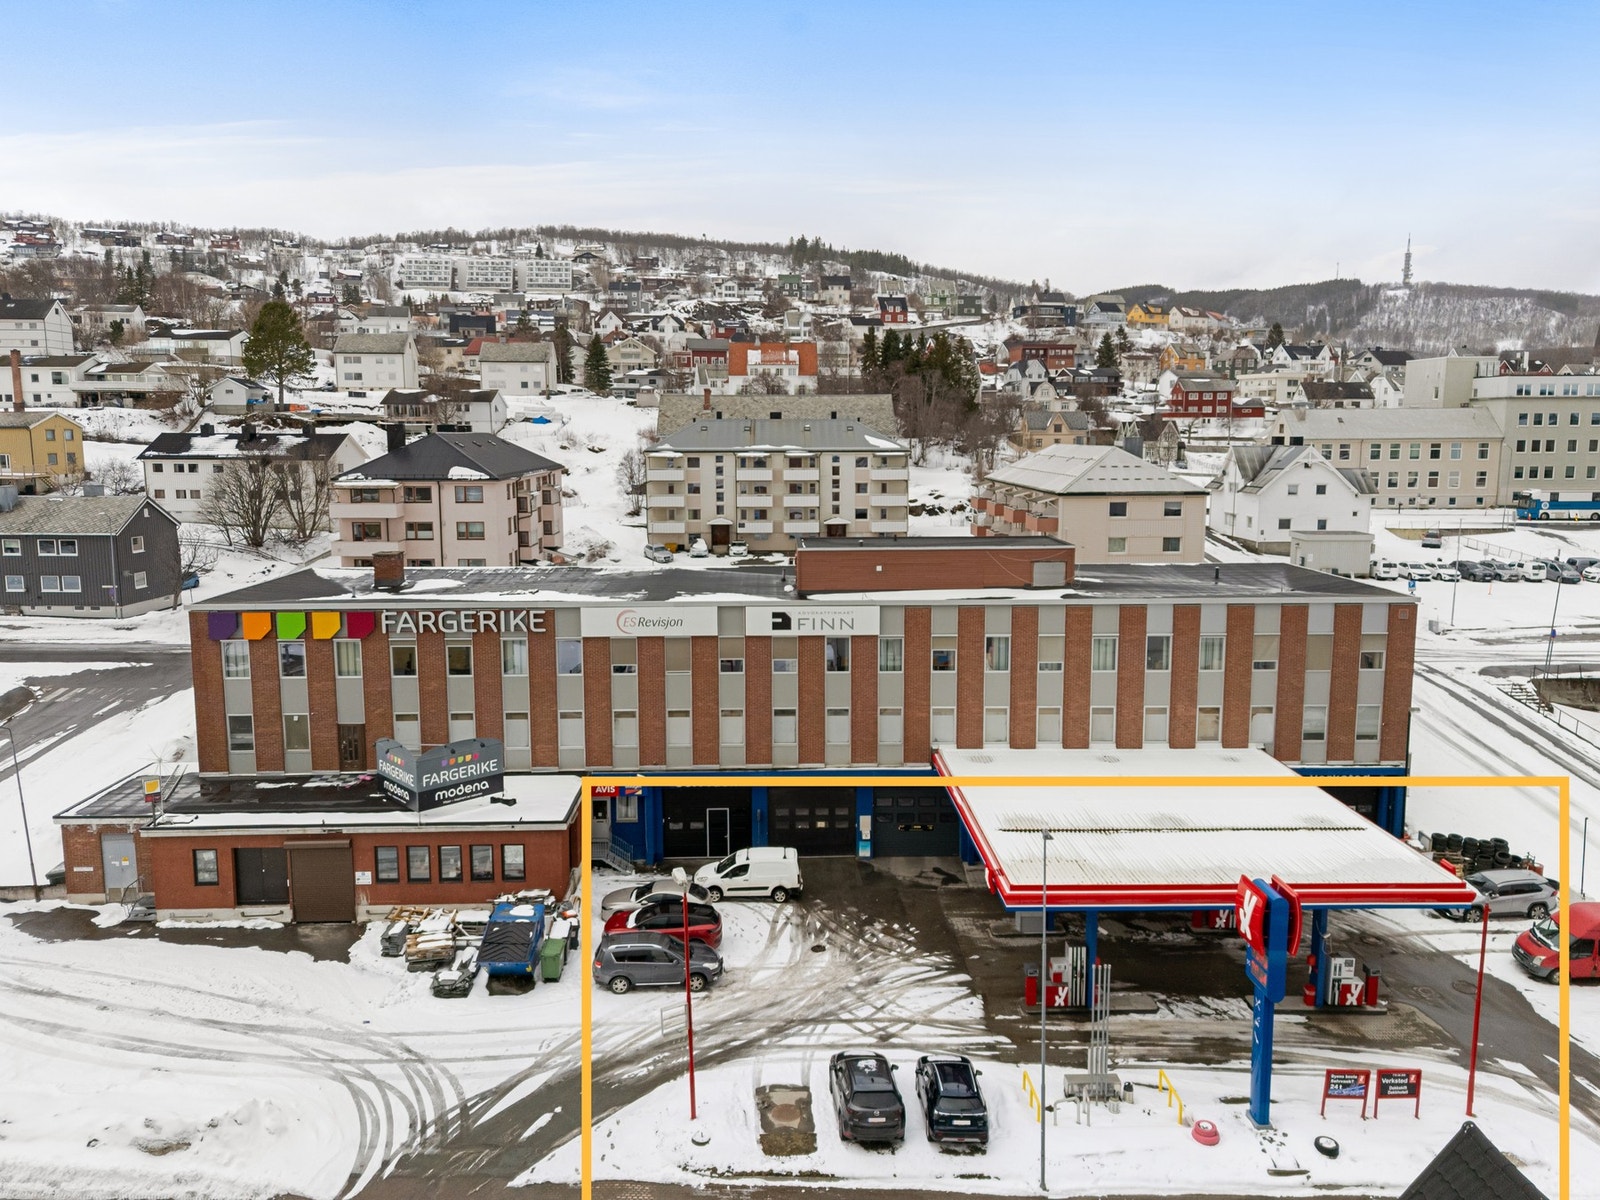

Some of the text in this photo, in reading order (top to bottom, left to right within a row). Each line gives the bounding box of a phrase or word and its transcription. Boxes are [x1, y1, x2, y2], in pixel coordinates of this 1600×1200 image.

[381, 609, 547, 634] FARGERIKE
[623, 616, 684, 630] ES Revisjon
[798, 618, 854, 630] FINN
[379, 760, 415, 787] FARGERIKE
[423, 759, 498, 787] FARGERIKE
[383, 780, 410, 801] modena
[435, 781, 489, 801] modena
[595, 785, 616, 793] AVIS
